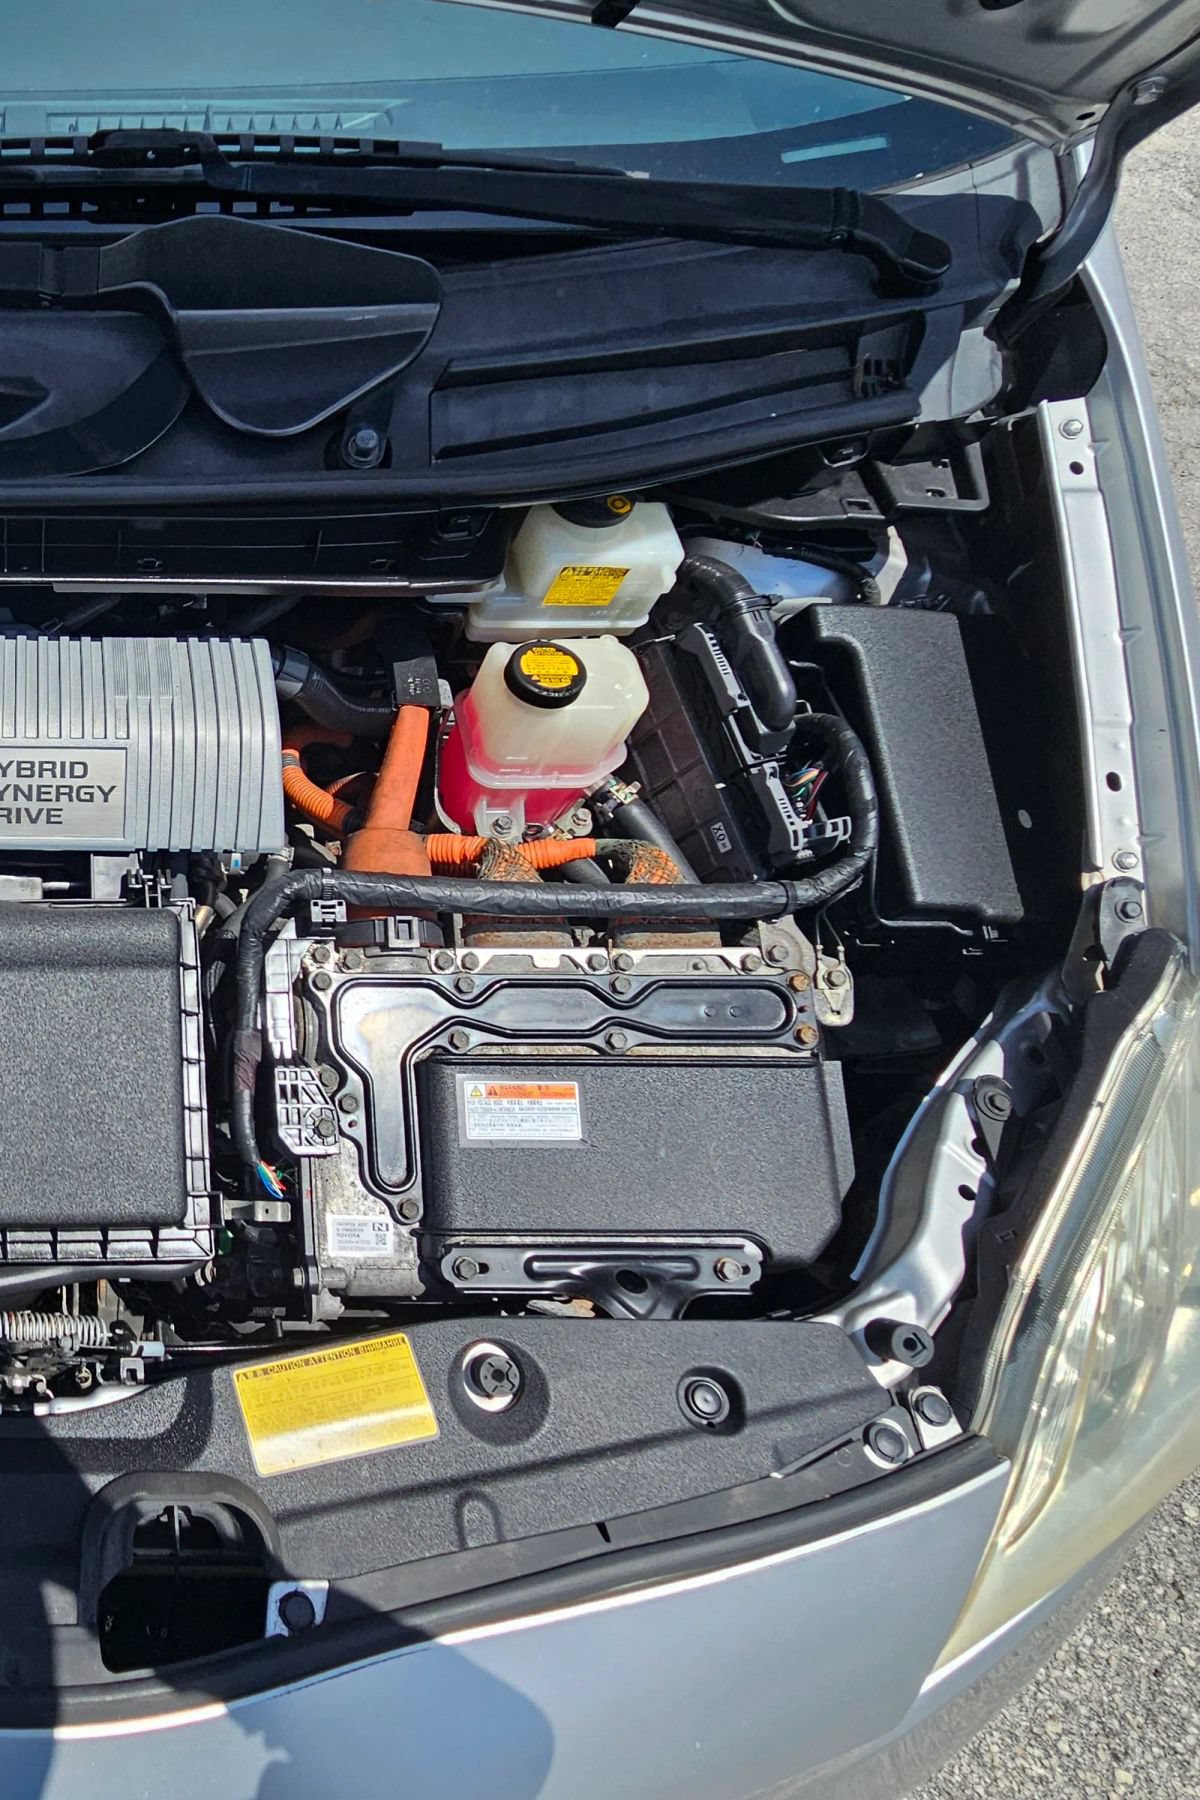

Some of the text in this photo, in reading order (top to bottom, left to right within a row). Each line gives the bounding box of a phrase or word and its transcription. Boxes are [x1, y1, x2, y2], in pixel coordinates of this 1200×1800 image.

[359, 1338, 405, 1355] ВНИМАНИЕ
[268, 1359, 305, 1375] CAUTION
[309, 1349, 355, 1366] ATTENTION
